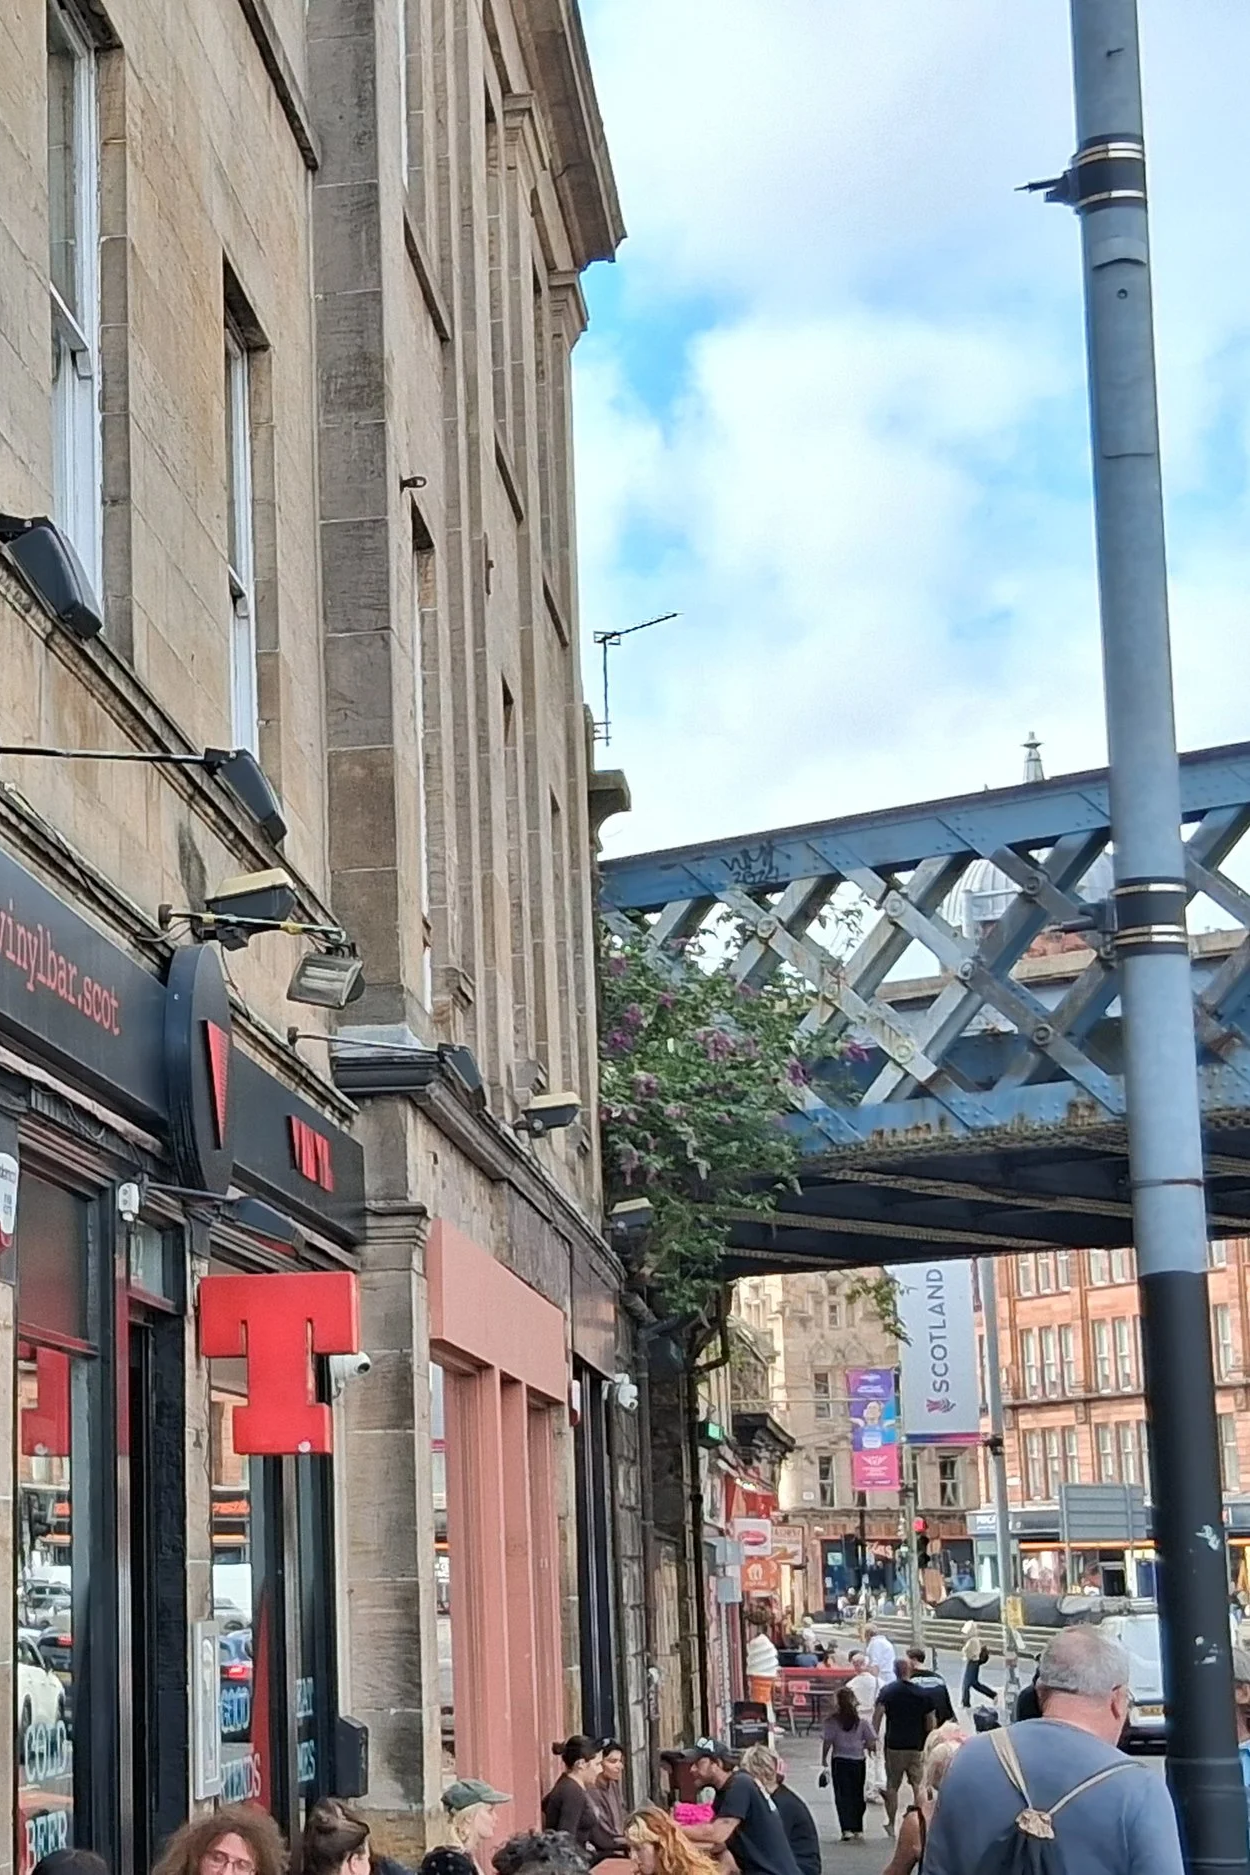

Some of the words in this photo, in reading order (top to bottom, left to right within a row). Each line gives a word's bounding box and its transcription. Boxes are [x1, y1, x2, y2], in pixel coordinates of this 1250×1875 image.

[198, 1272, 359, 1455] T
[925, 1268, 950, 1393] SCOTLAND
[25, 1720, 67, 1782] COLD
[25, 1811, 68, 1875] BEER
